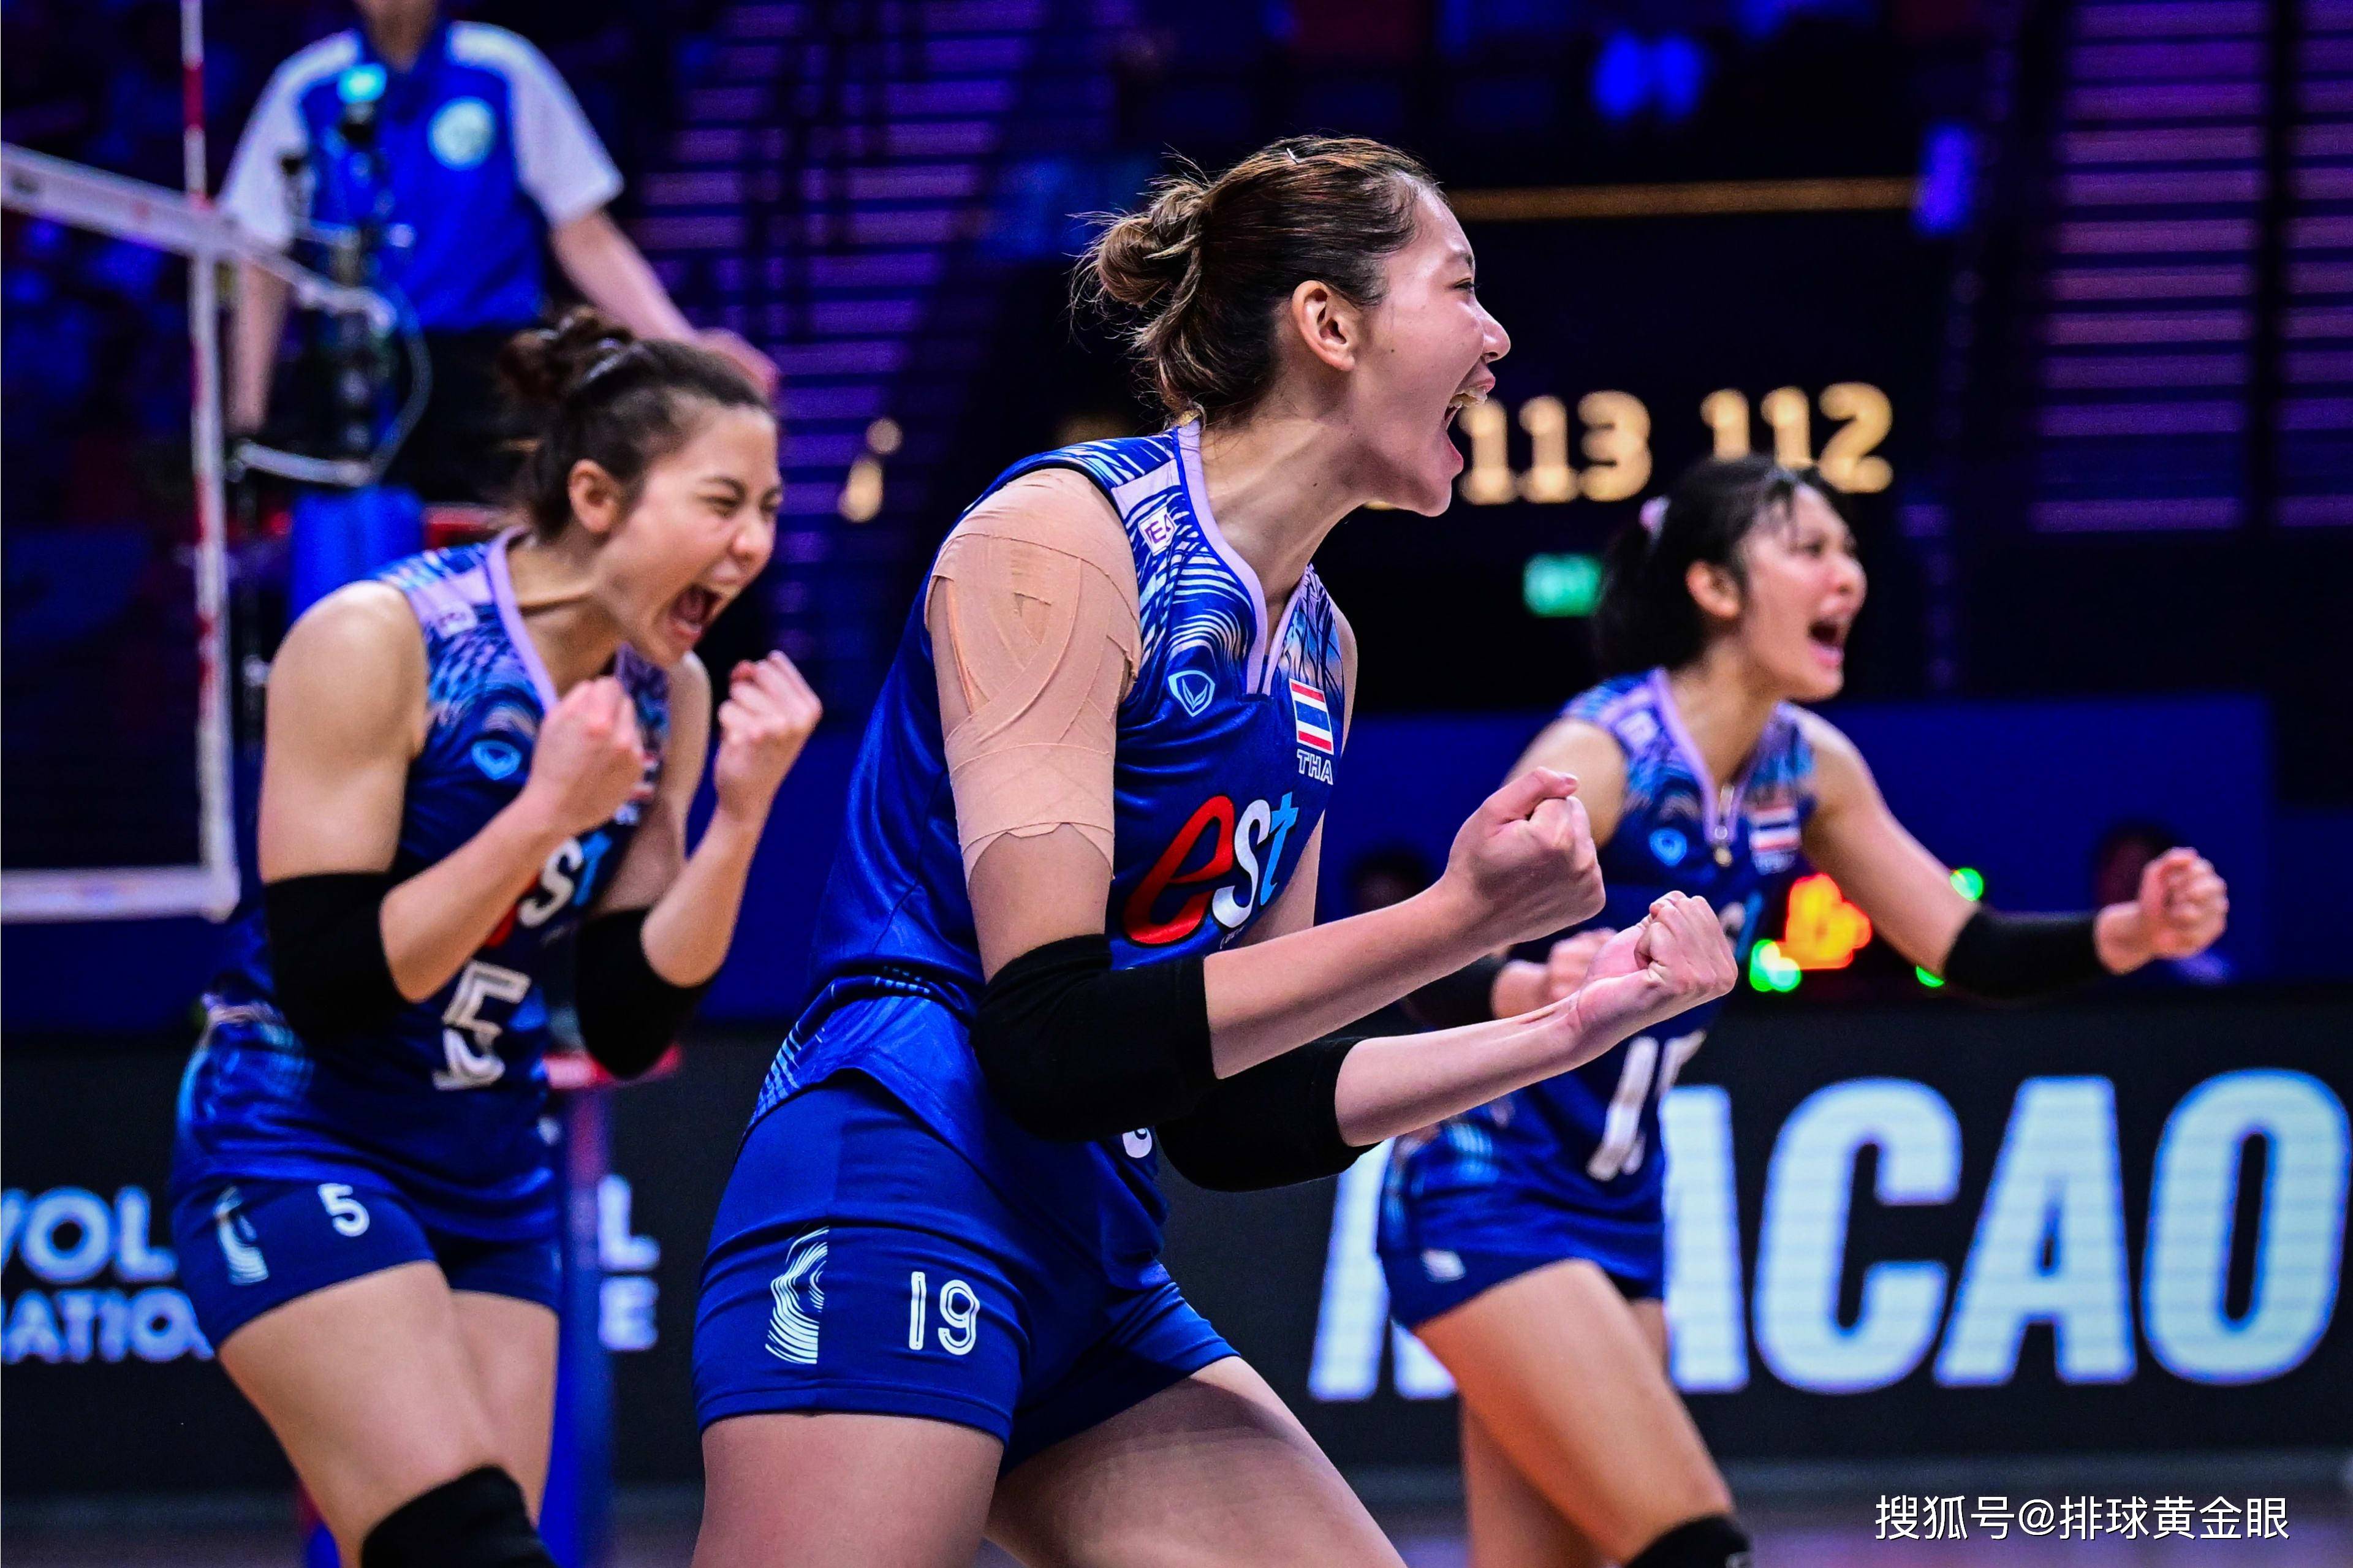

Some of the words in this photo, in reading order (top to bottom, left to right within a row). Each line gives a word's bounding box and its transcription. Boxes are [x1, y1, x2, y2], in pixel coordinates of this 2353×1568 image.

[1458, 393, 1653, 506] 113
[1297, 748, 1334, 786] THA
[484, 831, 612, 947] st
[1123, 791, 1299, 945] est
[317, 1183, 370, 1237] 5
[909, 1271, 980, 1356] 19
